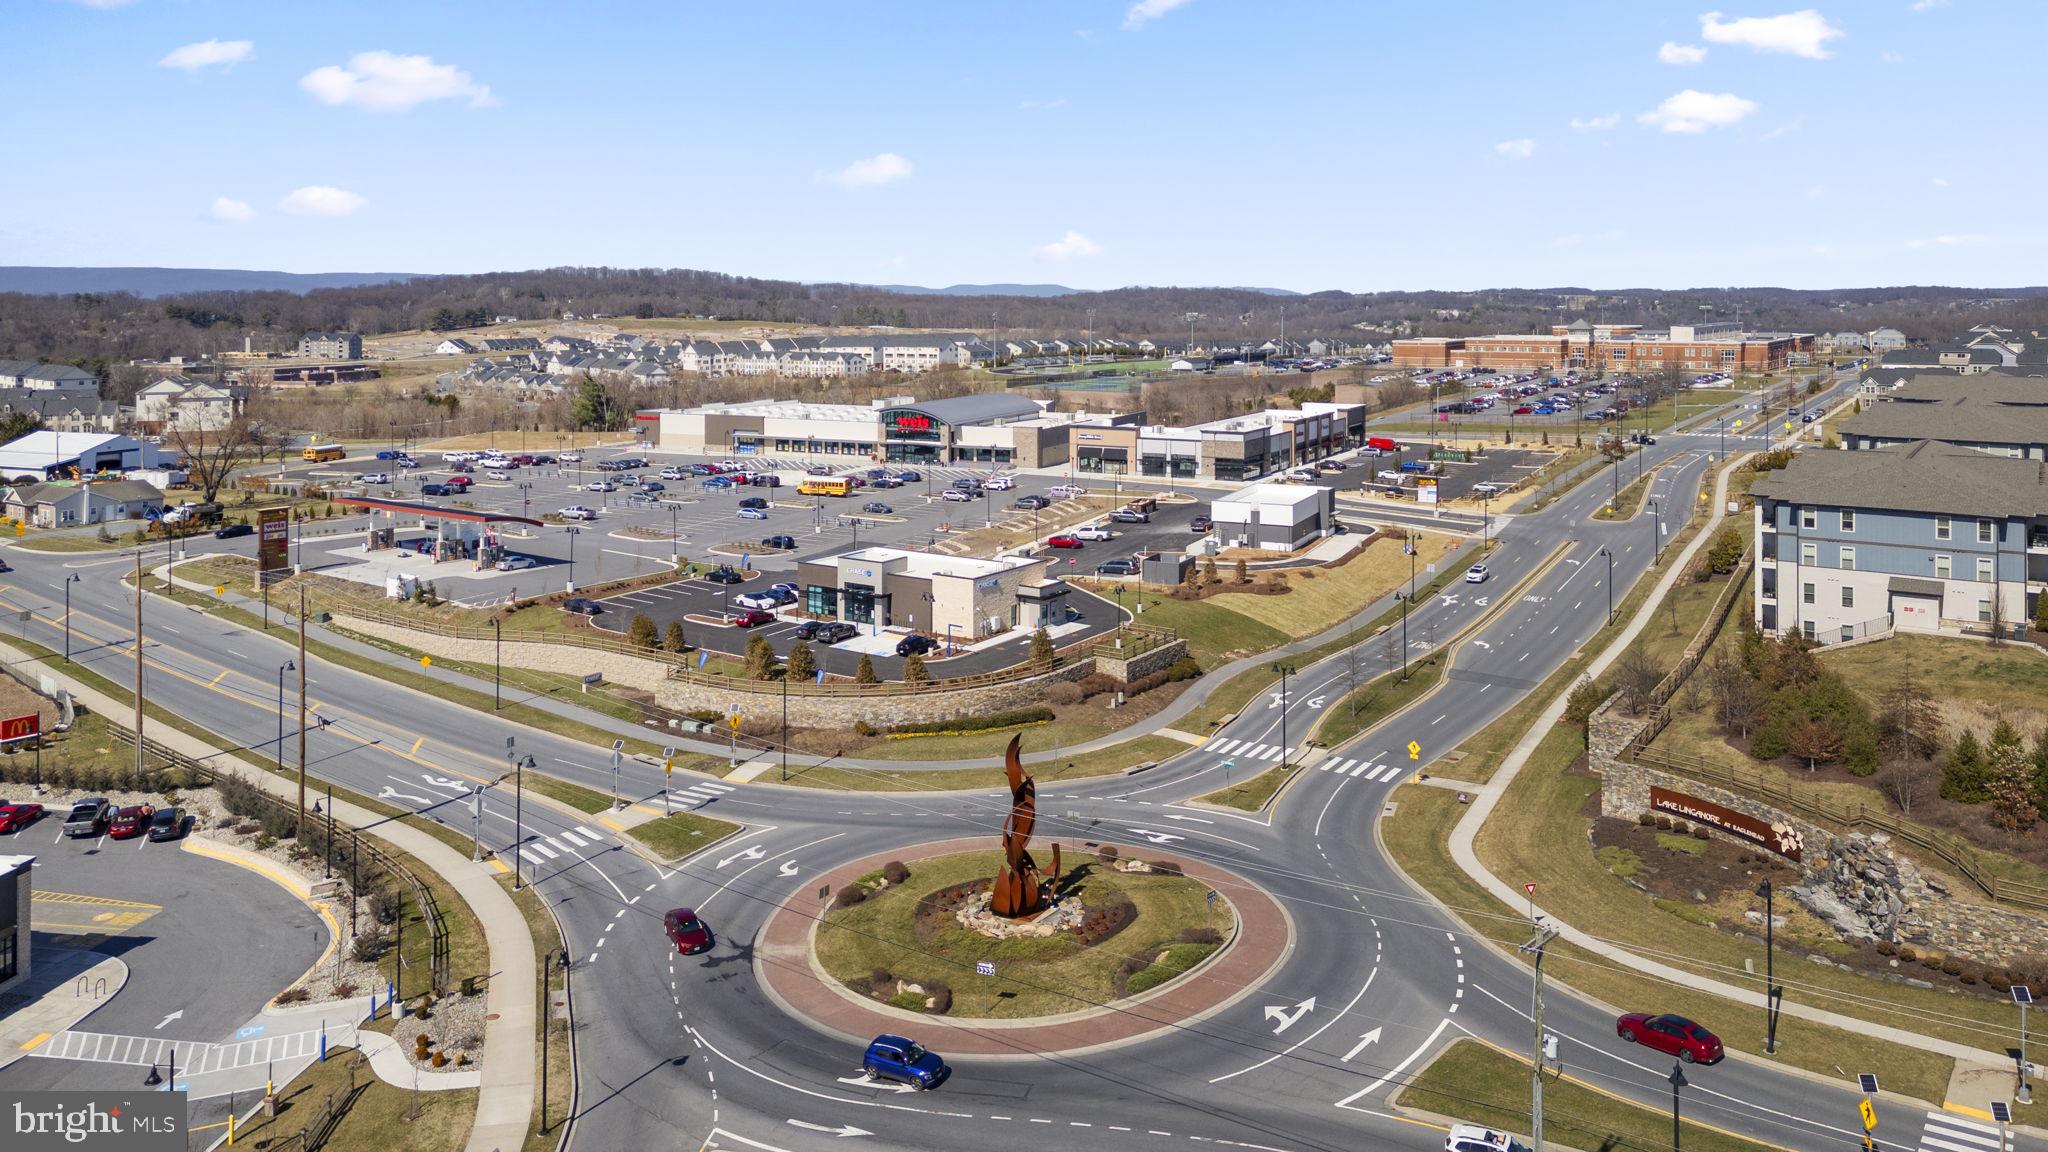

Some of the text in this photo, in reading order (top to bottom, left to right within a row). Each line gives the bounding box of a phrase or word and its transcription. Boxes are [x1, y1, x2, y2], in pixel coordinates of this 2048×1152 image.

[1523, 595, 1545, 603] ONLY
[1656, 798, 1677, 811] LAKE
[1678, 803, 1721, 824] LINGANORE
[1733, 824, 1765, 841] EAGLEHEAD
